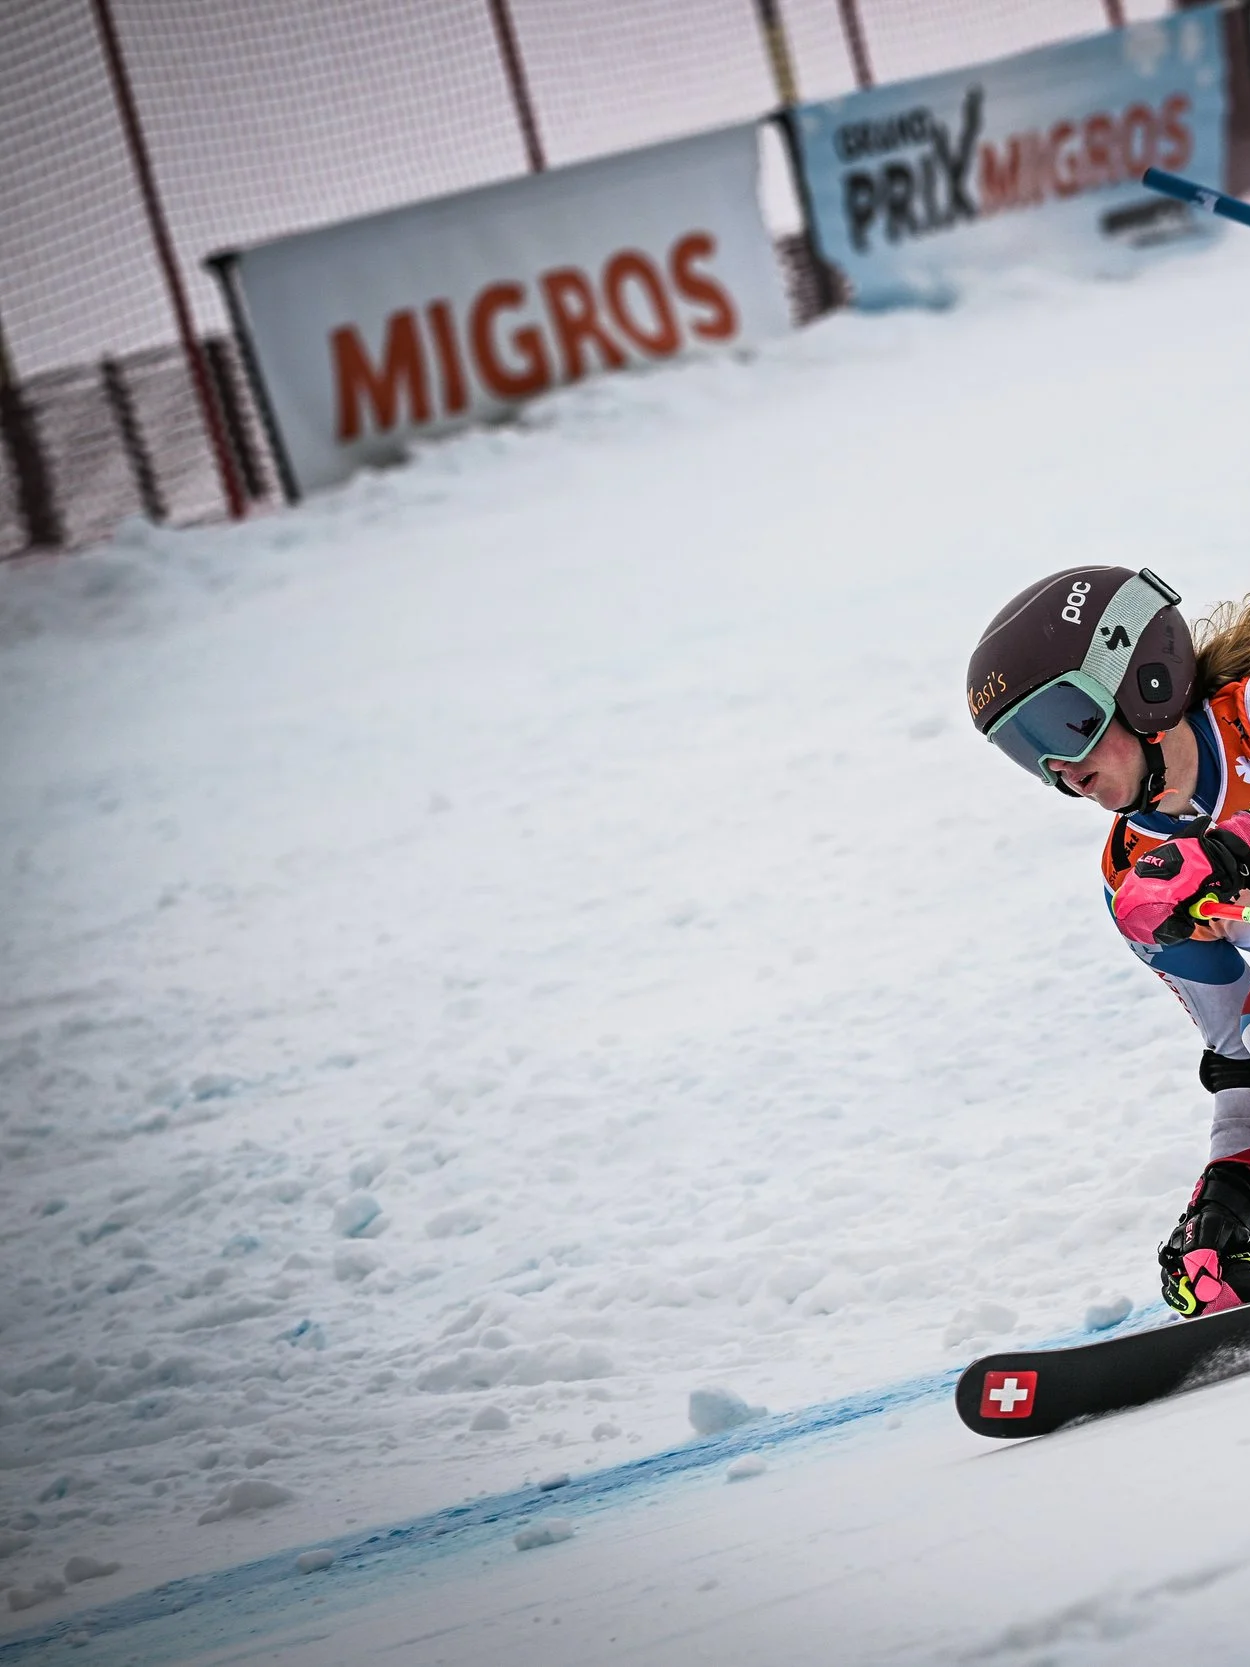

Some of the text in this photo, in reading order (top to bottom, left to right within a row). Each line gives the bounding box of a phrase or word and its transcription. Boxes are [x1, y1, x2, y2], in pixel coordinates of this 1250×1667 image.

[840, 84, 1195, 256] PRIX MIGROS
[329, 230, 739, 446] MIGROS
[1138, 855, 1165, 868] LEKI
